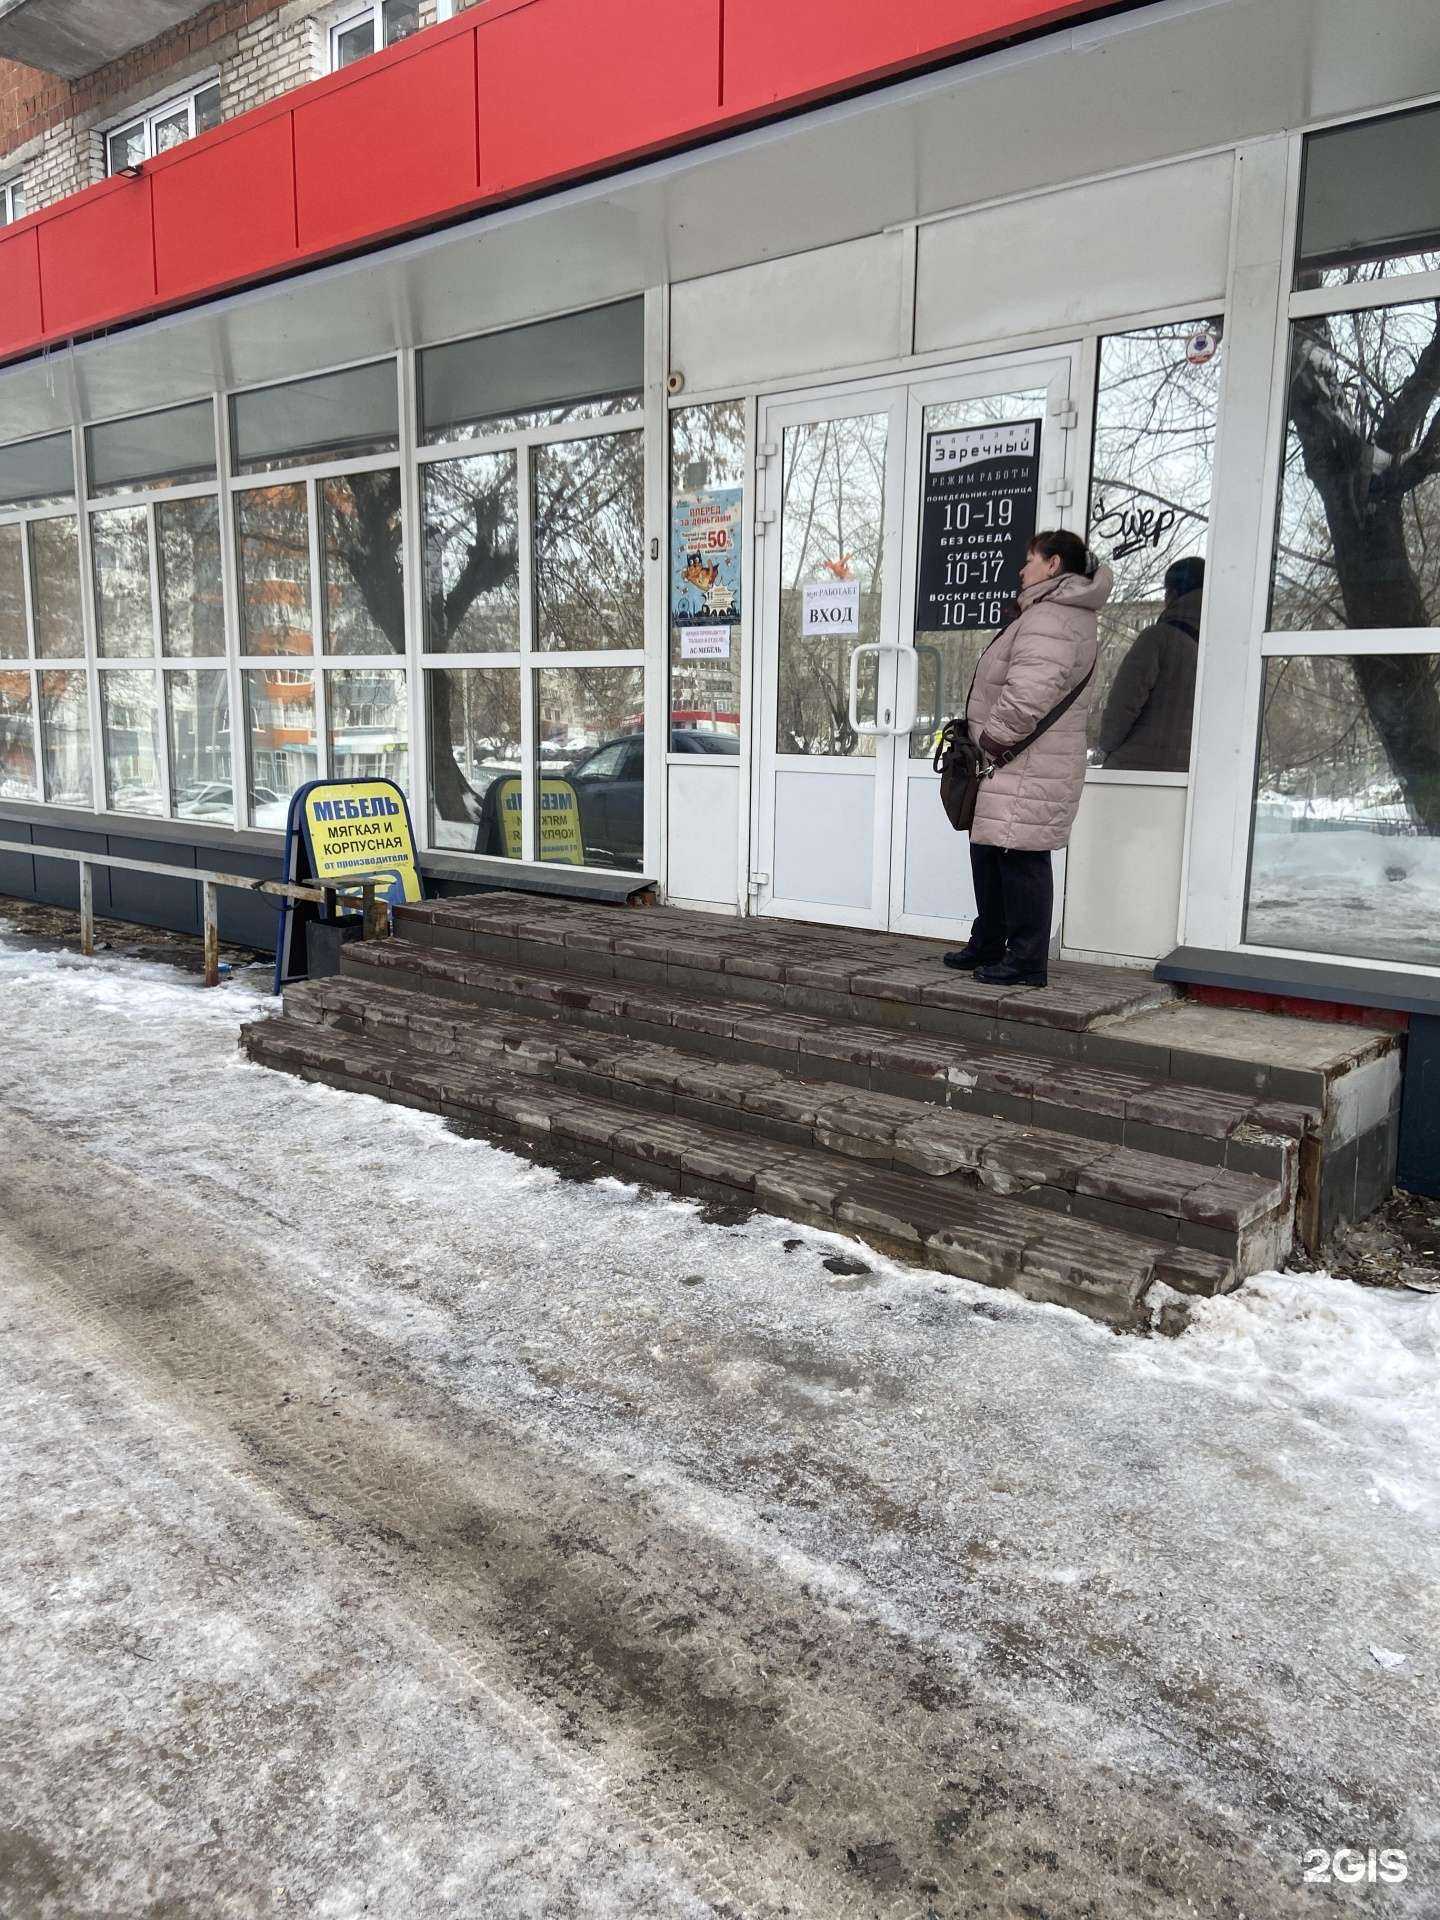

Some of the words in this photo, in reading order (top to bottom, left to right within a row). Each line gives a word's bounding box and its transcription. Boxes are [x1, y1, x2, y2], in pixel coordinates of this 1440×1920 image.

[934, 438, 1030, 463] Заречный
[931, 474, 975, 487] РЕЖИМ
[980, 467, 1030, 482] РАБОТЫ
[943, 498, 1013, 530] 10-19
[940, 536, 964, 546] БЕЗ
[967, 532, 1013, 545] ОБЕДА
[946, 550, 1004, 561] СУББОТА
[944, 559, 1005, 586] 10-17
[928, 590, 1017, 602] ВОСКРЕСЕНЬЕ
[809, 606, 853, 624] ВХОД
[941, 601, 1001, 626] 10-16
[313, 796, 401, 823] МЕБЕЛЬ
[327, 823, 380, 839] МЯГКАЯ
[383, 821, 393, 833] И
[323, 836, 403, 856] КОРПУСНАЯ
[324, 862, 335, 870] от
[336, 854, 409, 869] производителя
